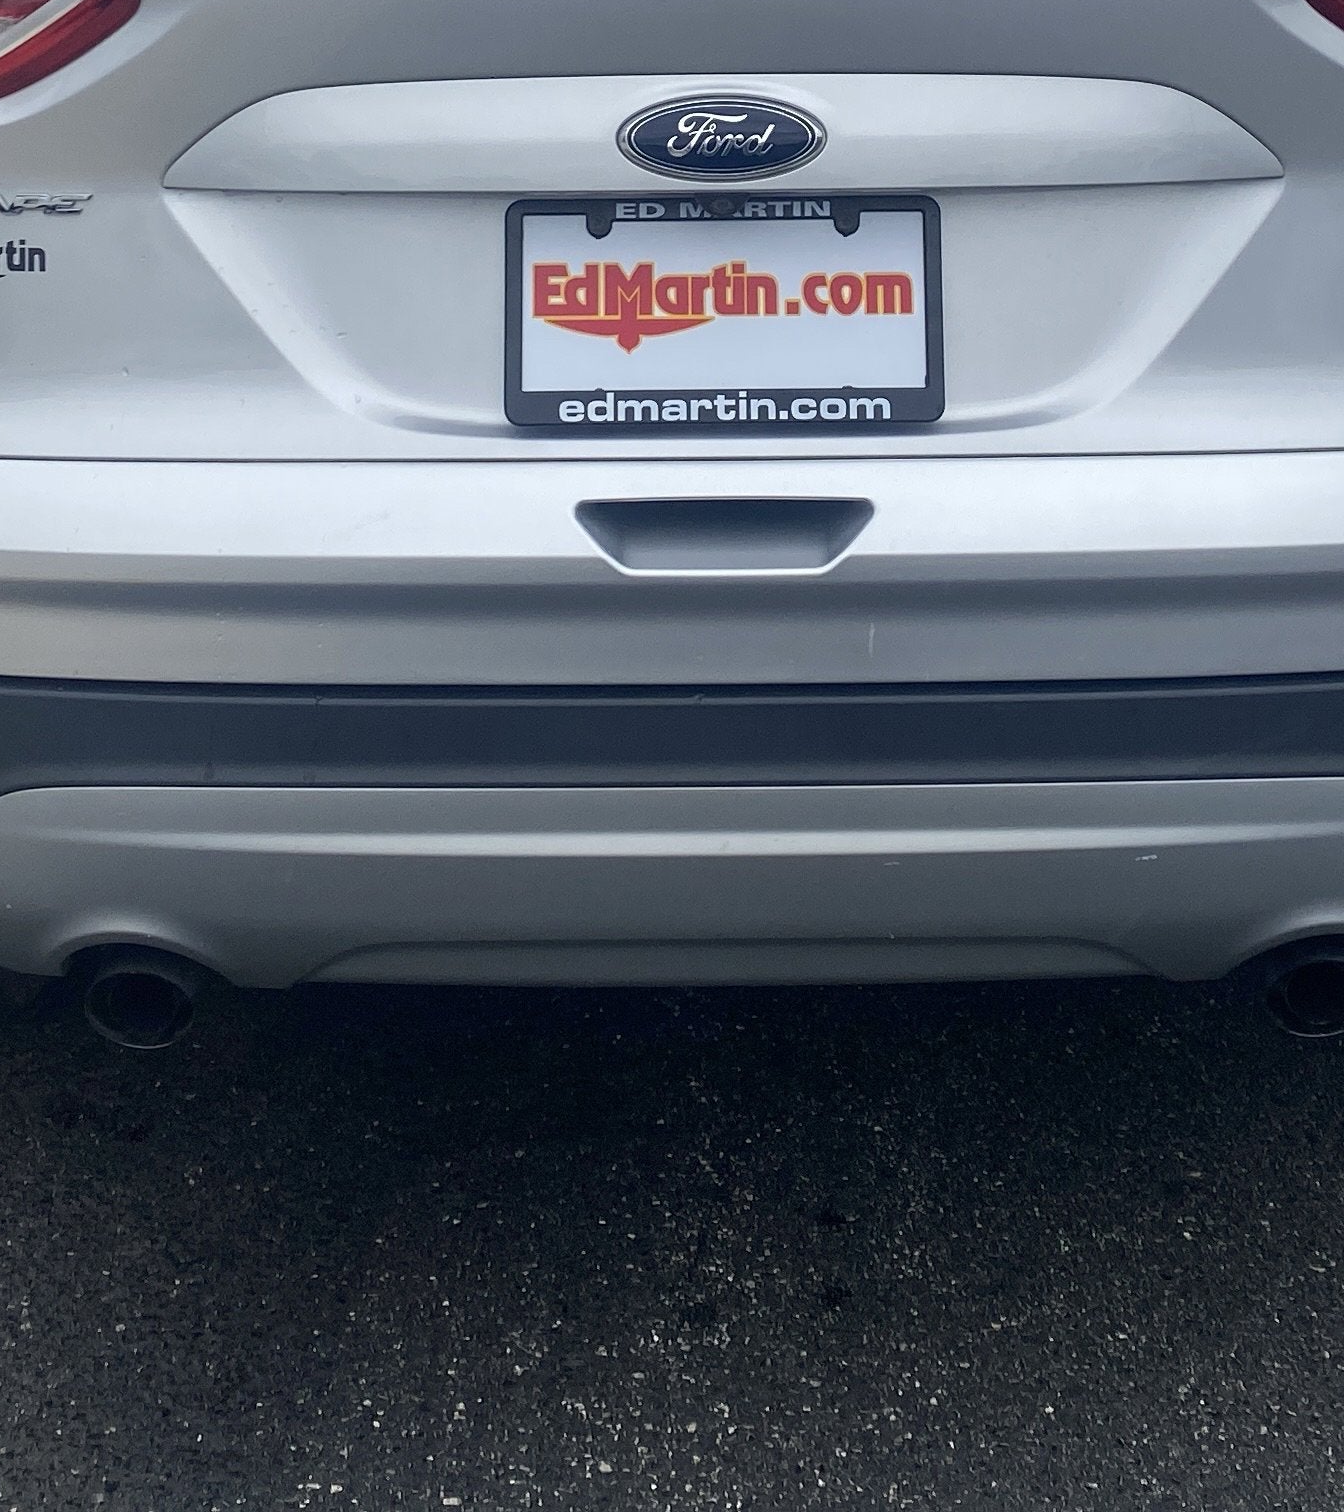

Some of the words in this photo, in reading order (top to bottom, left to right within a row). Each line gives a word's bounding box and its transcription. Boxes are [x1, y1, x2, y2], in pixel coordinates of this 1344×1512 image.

[666, 112, 774, 158] Ford
[615, 202, 666, 219] ED
[679, 200, 831, 219] MRTIN
[558, 391, 891, 423] edmartin.com
